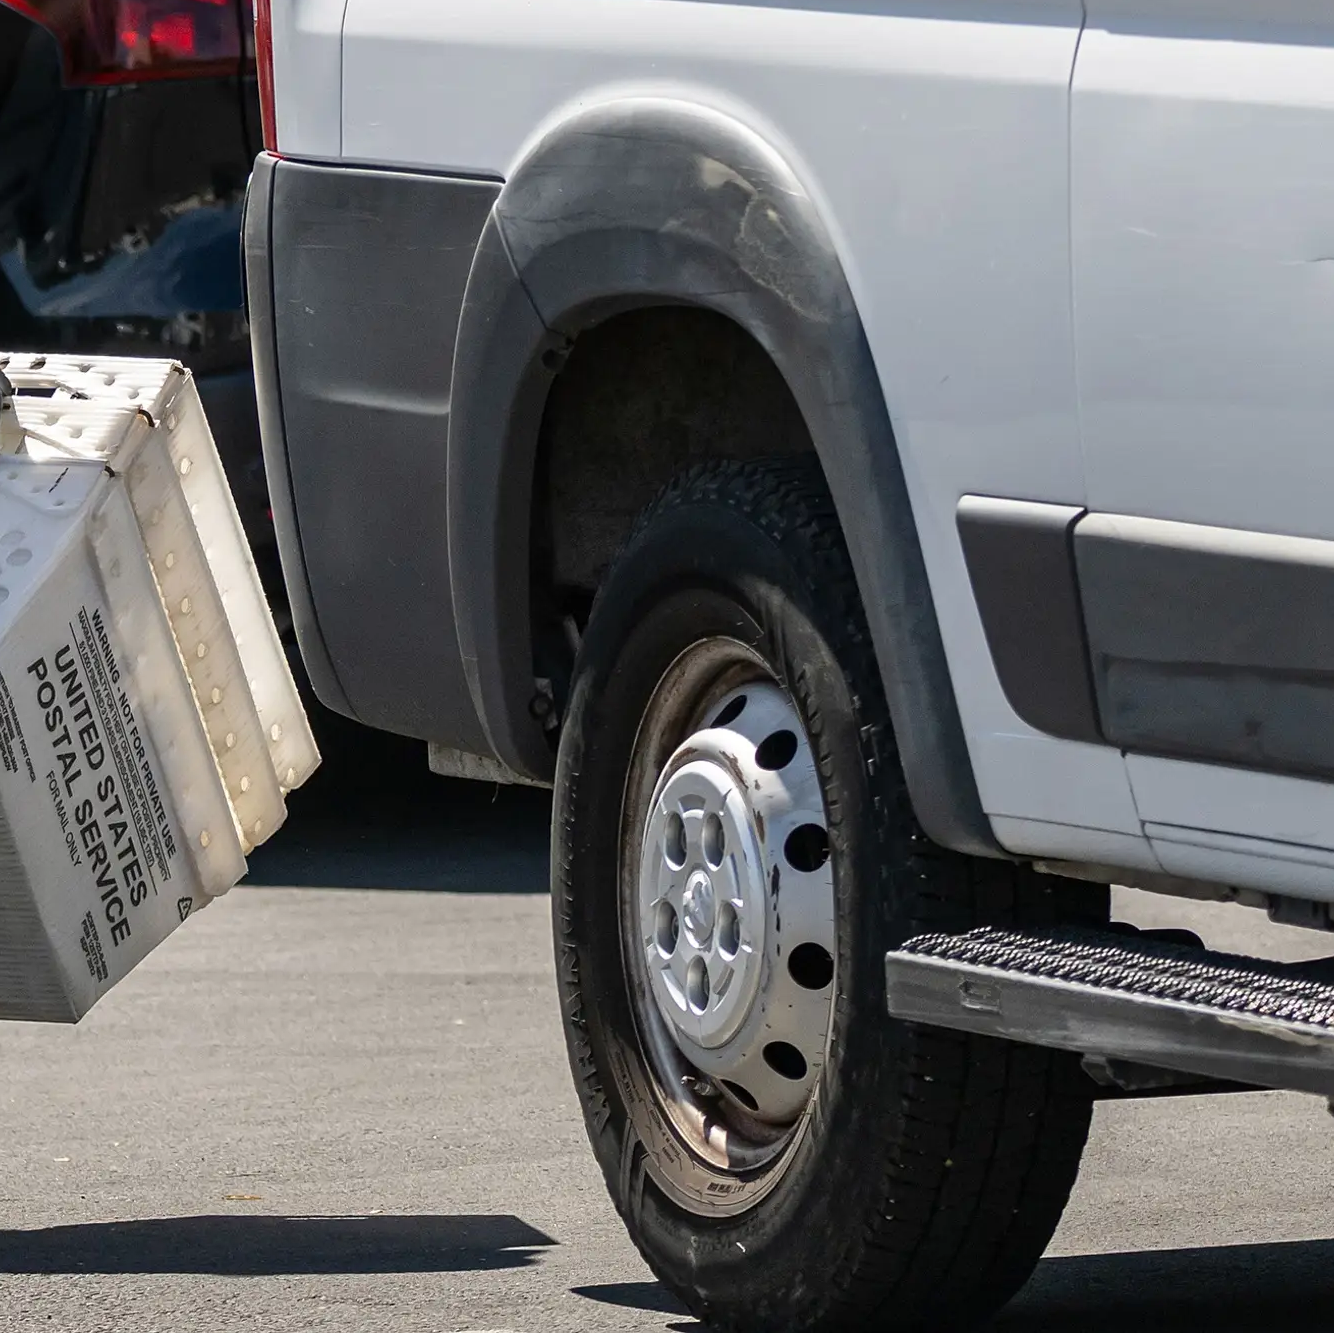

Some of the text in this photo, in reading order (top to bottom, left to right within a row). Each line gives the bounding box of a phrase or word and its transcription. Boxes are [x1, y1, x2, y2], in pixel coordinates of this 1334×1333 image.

[26, 656, 132, 948] POSTAL SERVICE
[45, 770, 83, 867] FOR MAIL ONLY
[54, 644, 148, 908] UNITED STATES
[91, 608, 121, 685] WARNING
[118, 691, 135, 726] NOT
[129, 725, 146, 763] FOR
[140, 760, 167, 827] PRIVATE
[161, 823, 177, 860] USE
[91, 652, 109, 692] PENALTY
[104, 691, 115, 714] FOR
[120, 740, 129, 757] OR
[136, 787, 144, 801] OF
[140, 800, 154, 838] POSTAL
